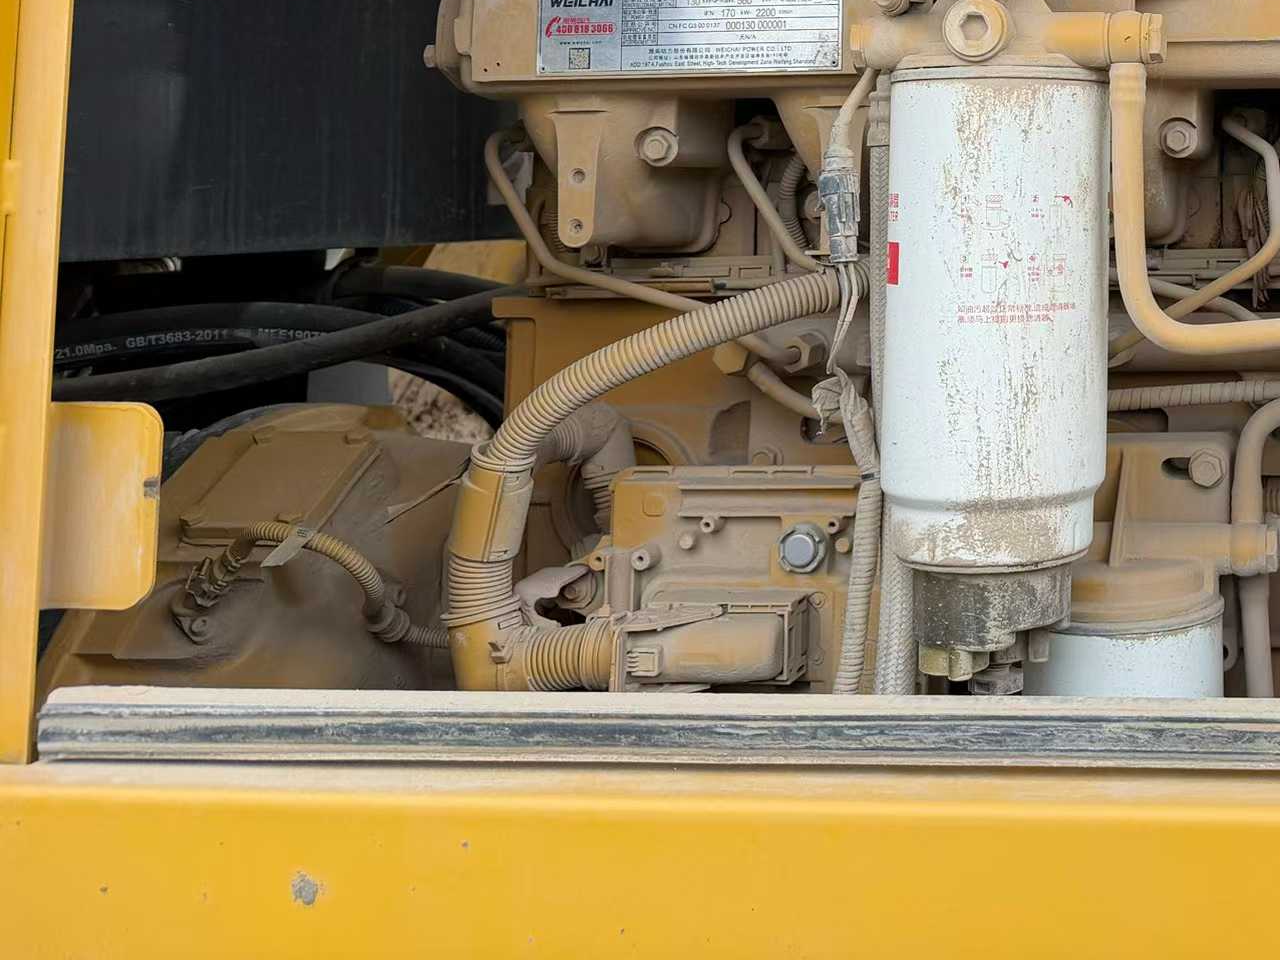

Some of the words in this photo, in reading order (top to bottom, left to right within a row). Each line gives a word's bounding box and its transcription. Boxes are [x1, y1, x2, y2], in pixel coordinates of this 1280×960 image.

[721, 8, 736, 17] 170
[756, 8, 777, 17] 2200
[125, 328, 228, 349] GB/T3683-2011
